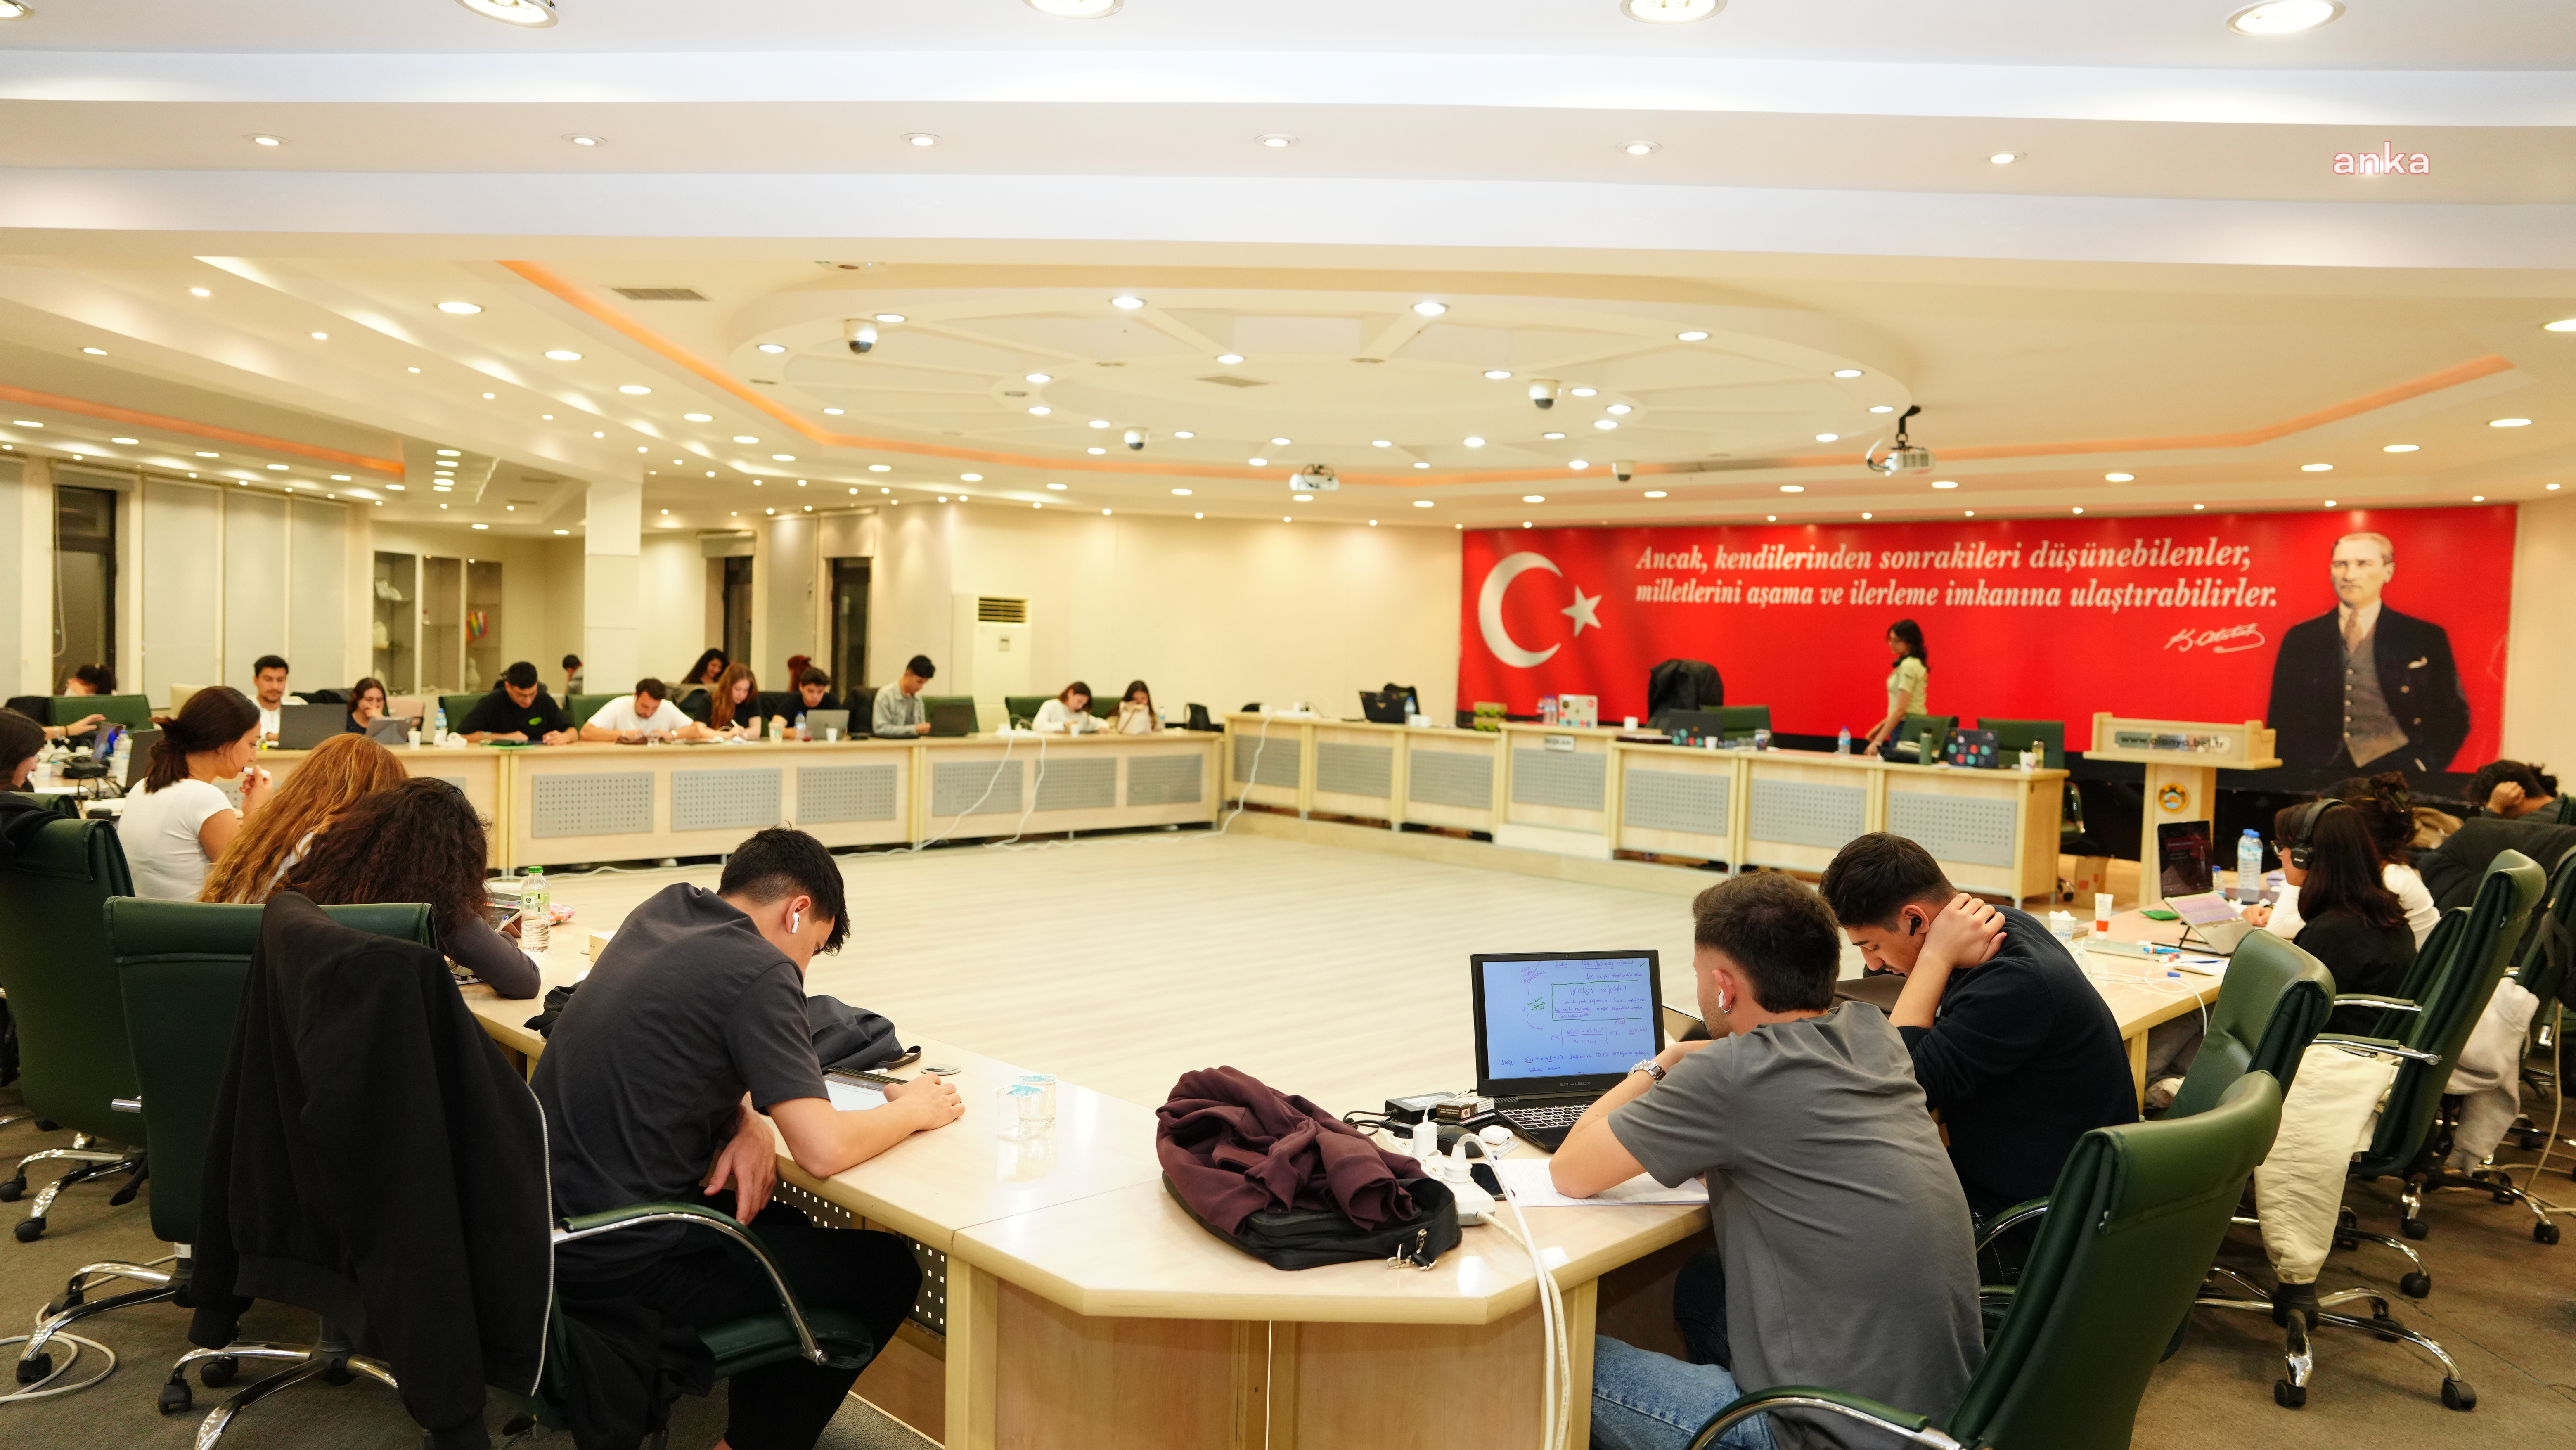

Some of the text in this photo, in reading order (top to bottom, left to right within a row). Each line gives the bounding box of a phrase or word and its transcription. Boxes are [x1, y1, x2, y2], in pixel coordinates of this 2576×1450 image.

[1636, 537, 2251, 574] Ancak, kendilerinden sonrakileri düşünebilenler,
[1636, 578, 2277, 613] milletlerini aşama ve ilerleme imkanına ulaştırabilirler.
